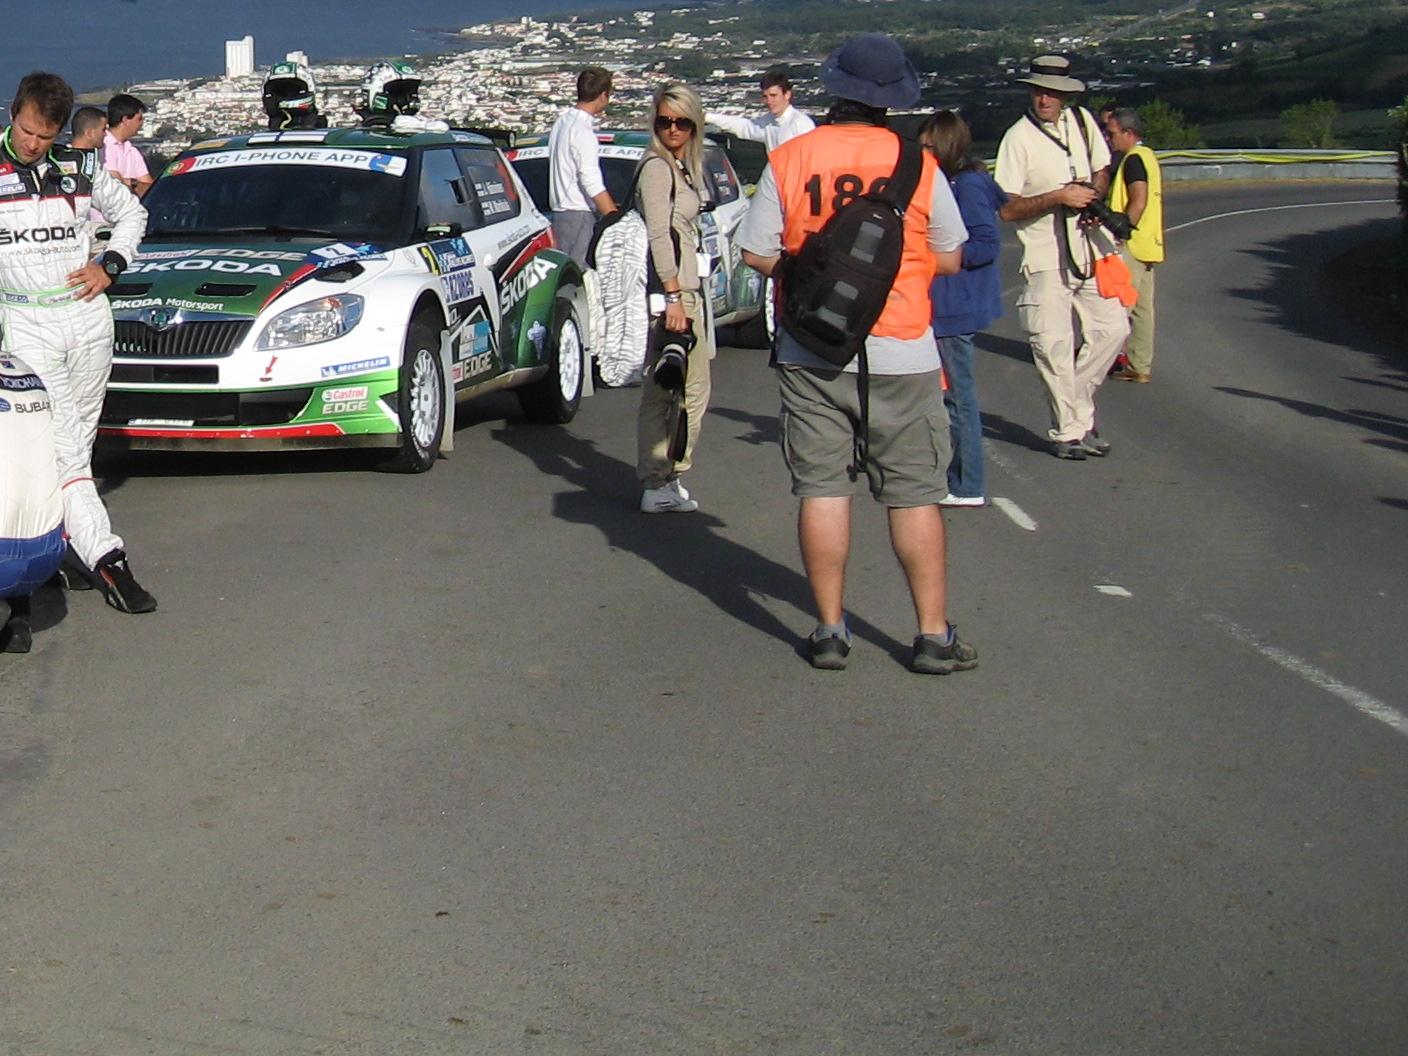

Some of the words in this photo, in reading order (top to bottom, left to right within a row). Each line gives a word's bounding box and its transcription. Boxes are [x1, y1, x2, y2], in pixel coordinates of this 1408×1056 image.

[195, 155, 229, 167] IRC
[325, 153, 368, 164] APP
[195, 248, 308, 262] EDGE
[501, 255, 558, 316] ŠKODA
[111, 297, 163, 309] ŠKODA
[165, 297, 225, 311] Motorsport
[337, 358, 388, 373] MICHELIN
[464, 355, 493, 380] EDGE
[333, 388, 365, 400] Castrol
[322, 400, 369, 415] EDGE
